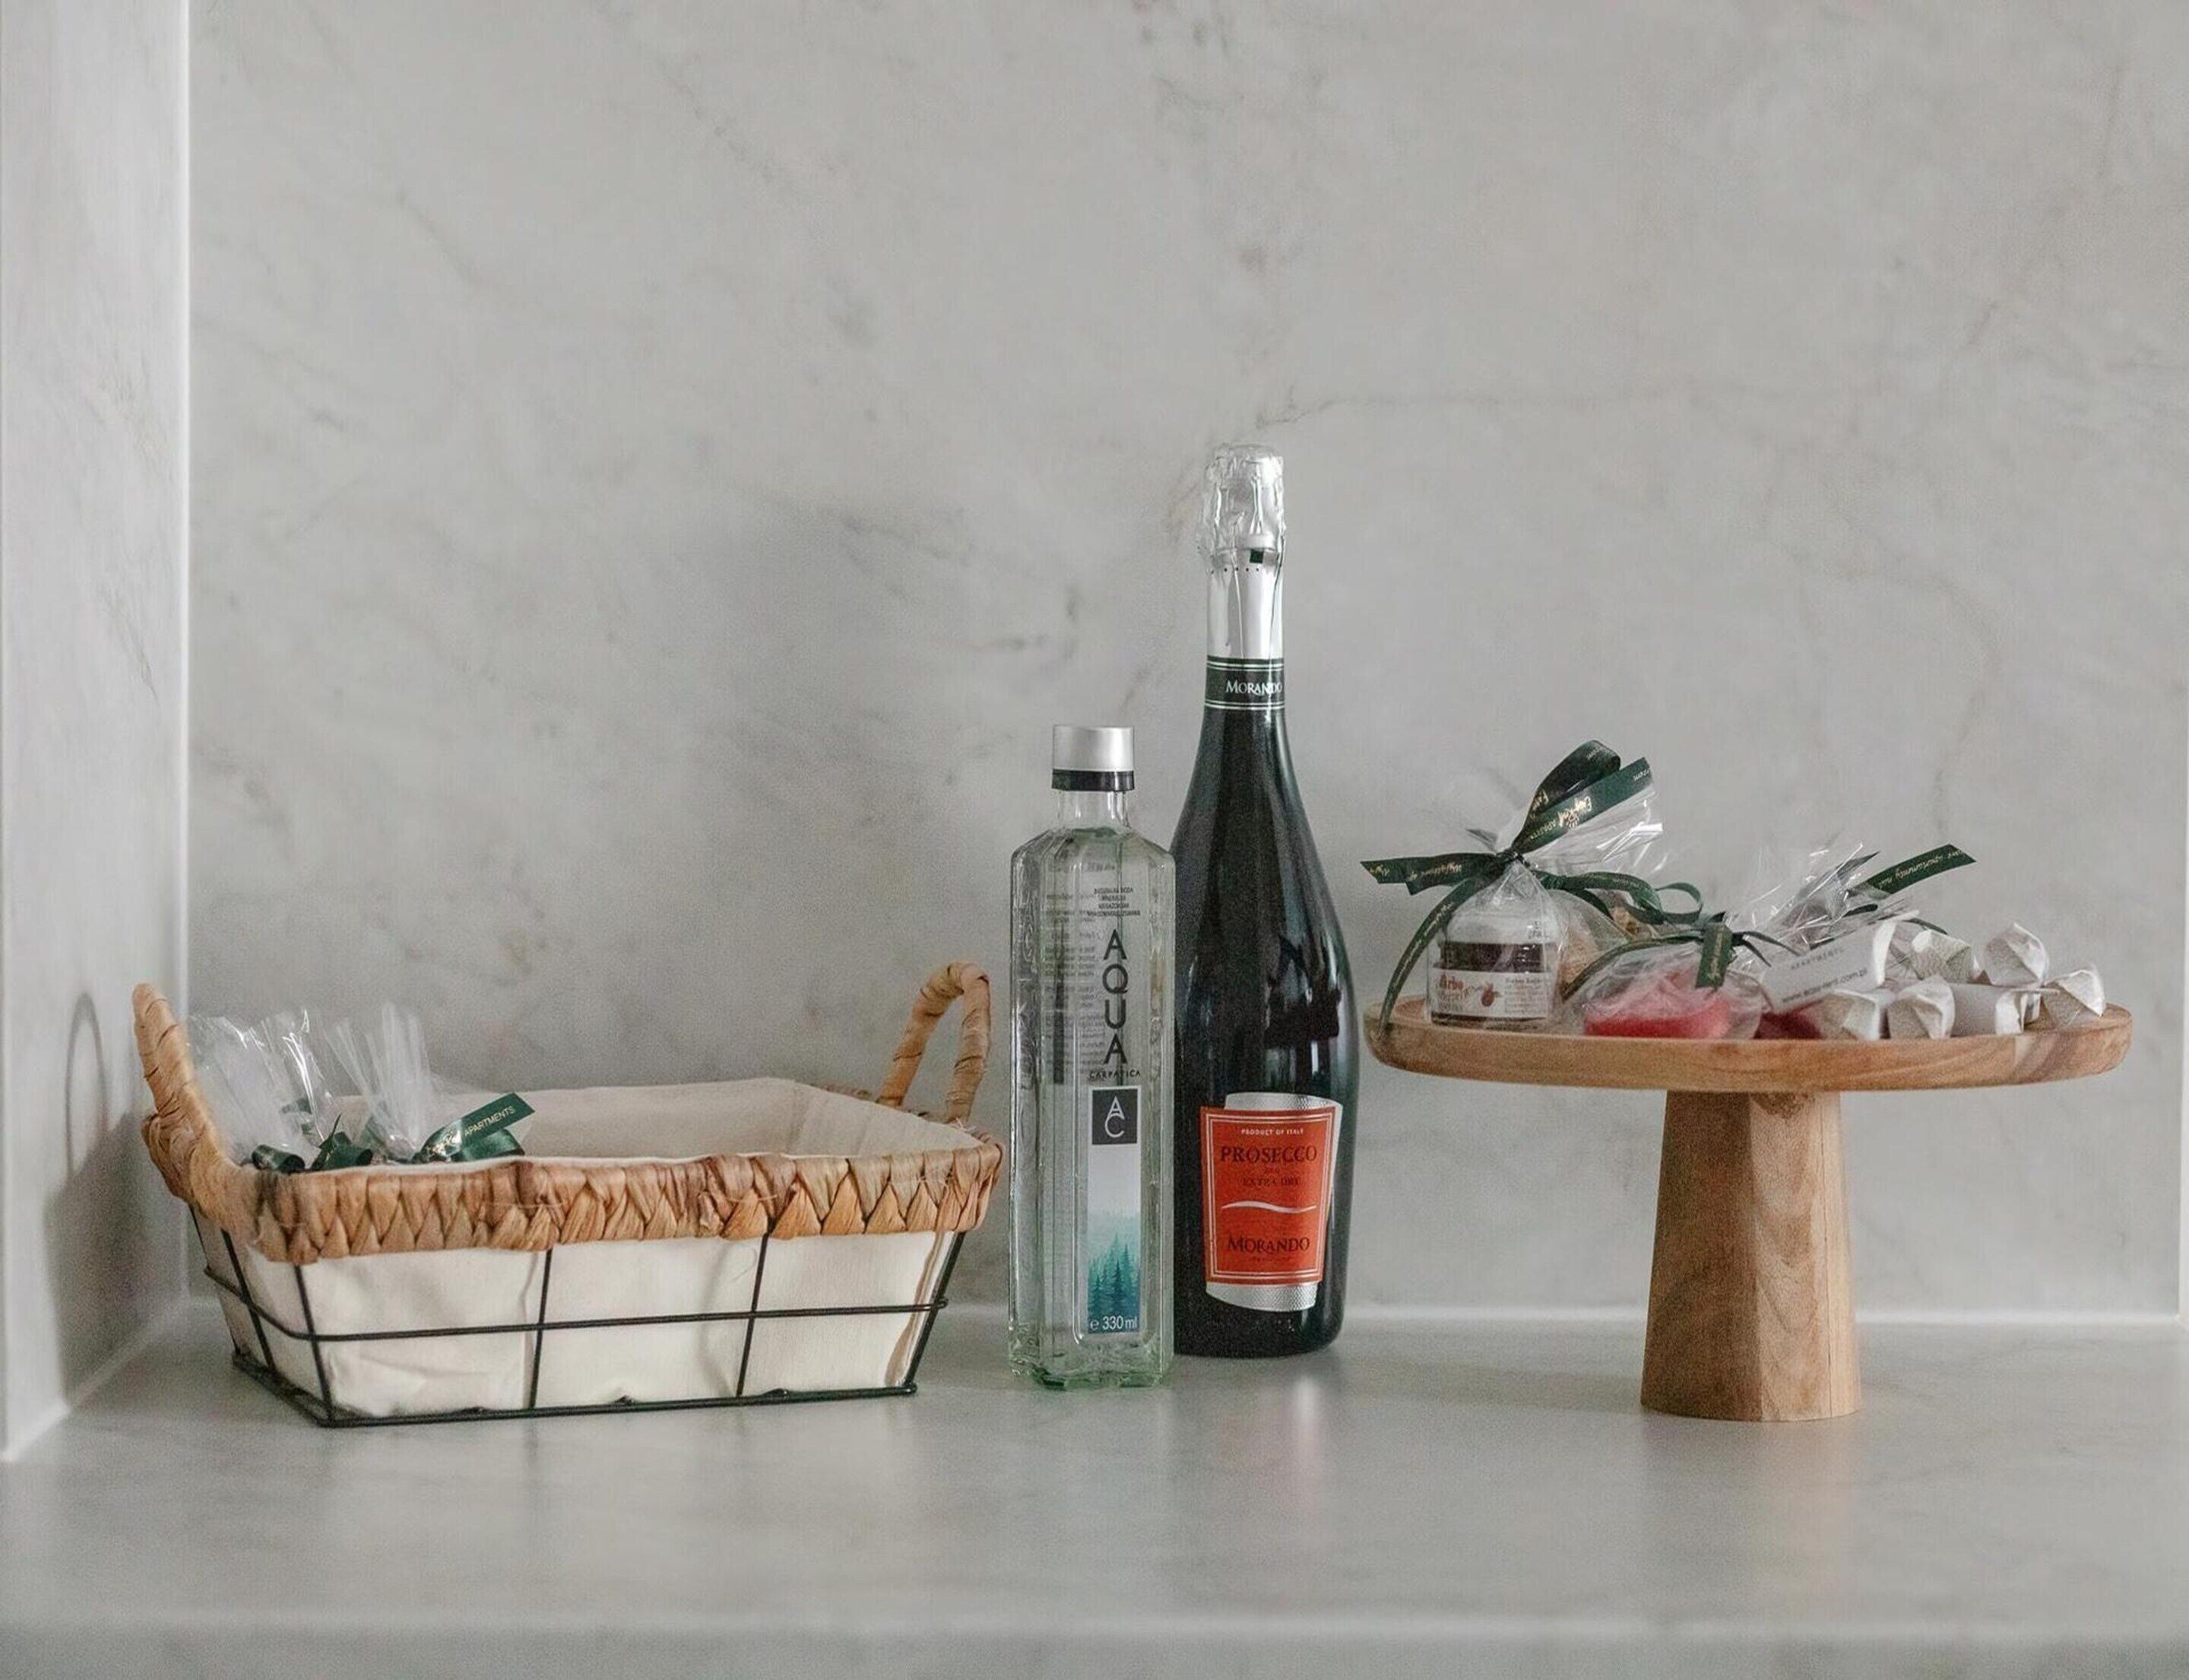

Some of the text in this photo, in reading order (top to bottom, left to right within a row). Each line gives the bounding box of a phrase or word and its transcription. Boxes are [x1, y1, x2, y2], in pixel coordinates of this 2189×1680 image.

[1102, 929, 1129, 1064] AQUA
[464, 1105, 515, 1137] APARTMENTS
[1240, 1128, 1273, 1136] PRODUCT
[1220, 1145, 1317, 1164] PROSECCO
[1228, 1235, 1310, 1254] MORANDO
[1102, 1315, 1124, 1330] 330
[1125, 1315, 1139, 1330] ml
